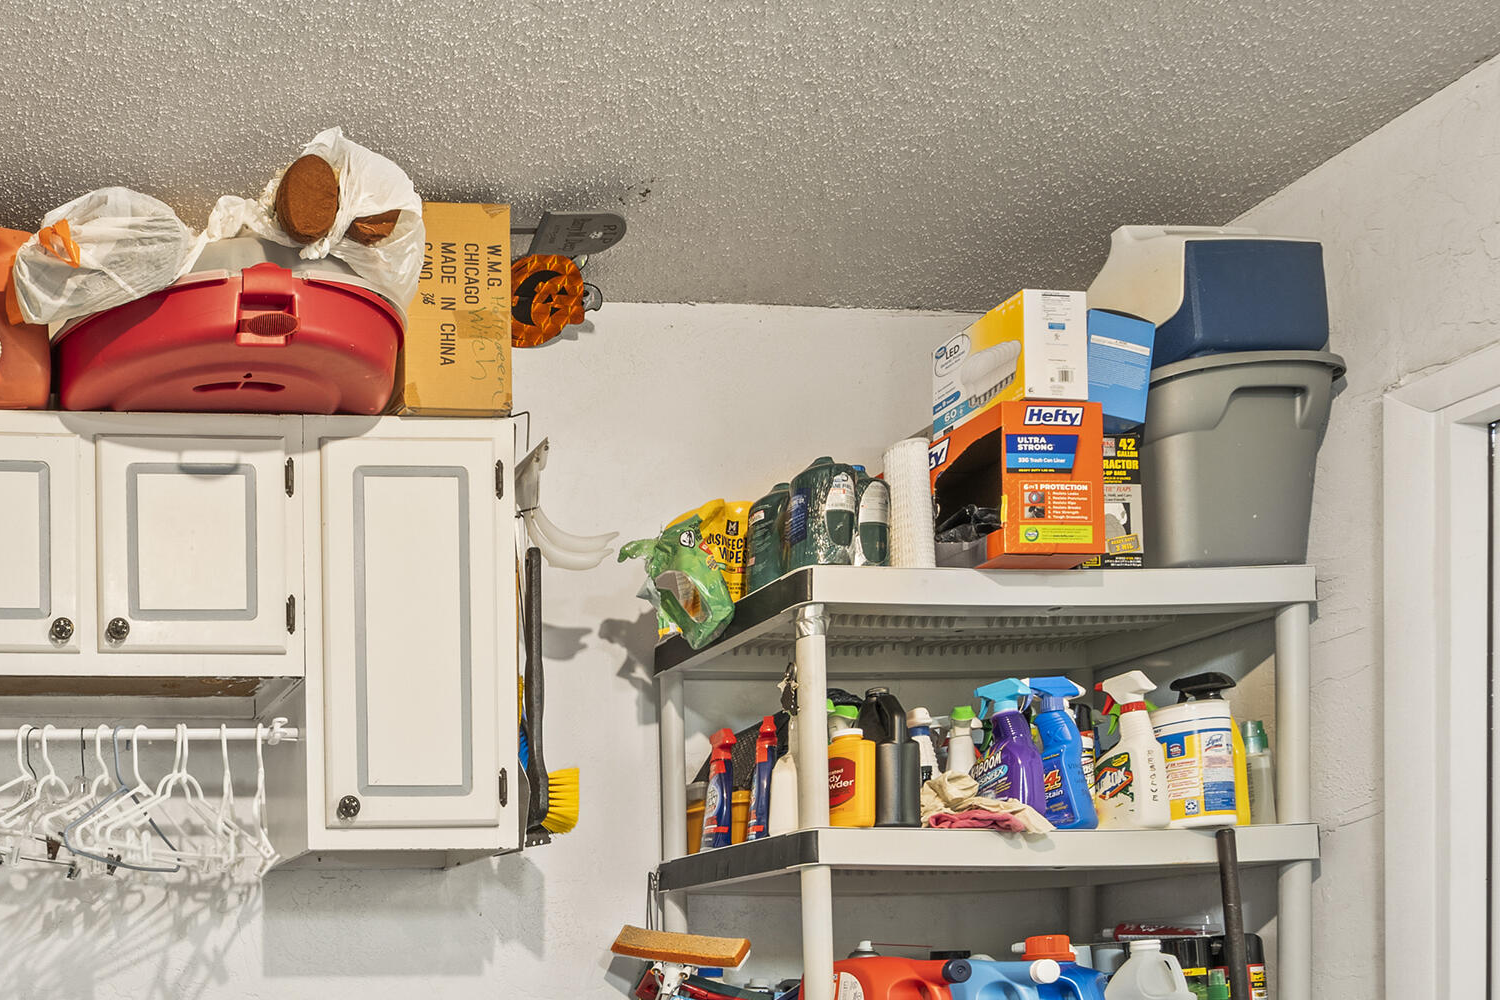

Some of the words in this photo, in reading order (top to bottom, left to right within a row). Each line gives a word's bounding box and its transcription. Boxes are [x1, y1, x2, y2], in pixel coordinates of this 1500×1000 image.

[440, 242, 457, 285] MADE
[486, 244, 503, 291] W.M.G.
[463, 242, 480, 305] CHICAGO
[440, 296, 457, 311] IN
[439, 322, 457, 366] CHINA
[945, 344, 960, 360] LED
[943, 408, 957, 422] 60
[1027, 408, 1080, 426] Hefty
[1017, 436, 1047, 444] ULTRA
[1017, 443, 1054, 451] STRONG
[1118, 438, 1136, 450] 42
[1103, 459, 1139, 470] RACTOR
[1039, 483, 1089, 491] PROTECTION
[829, 779, 855, 790] wder
